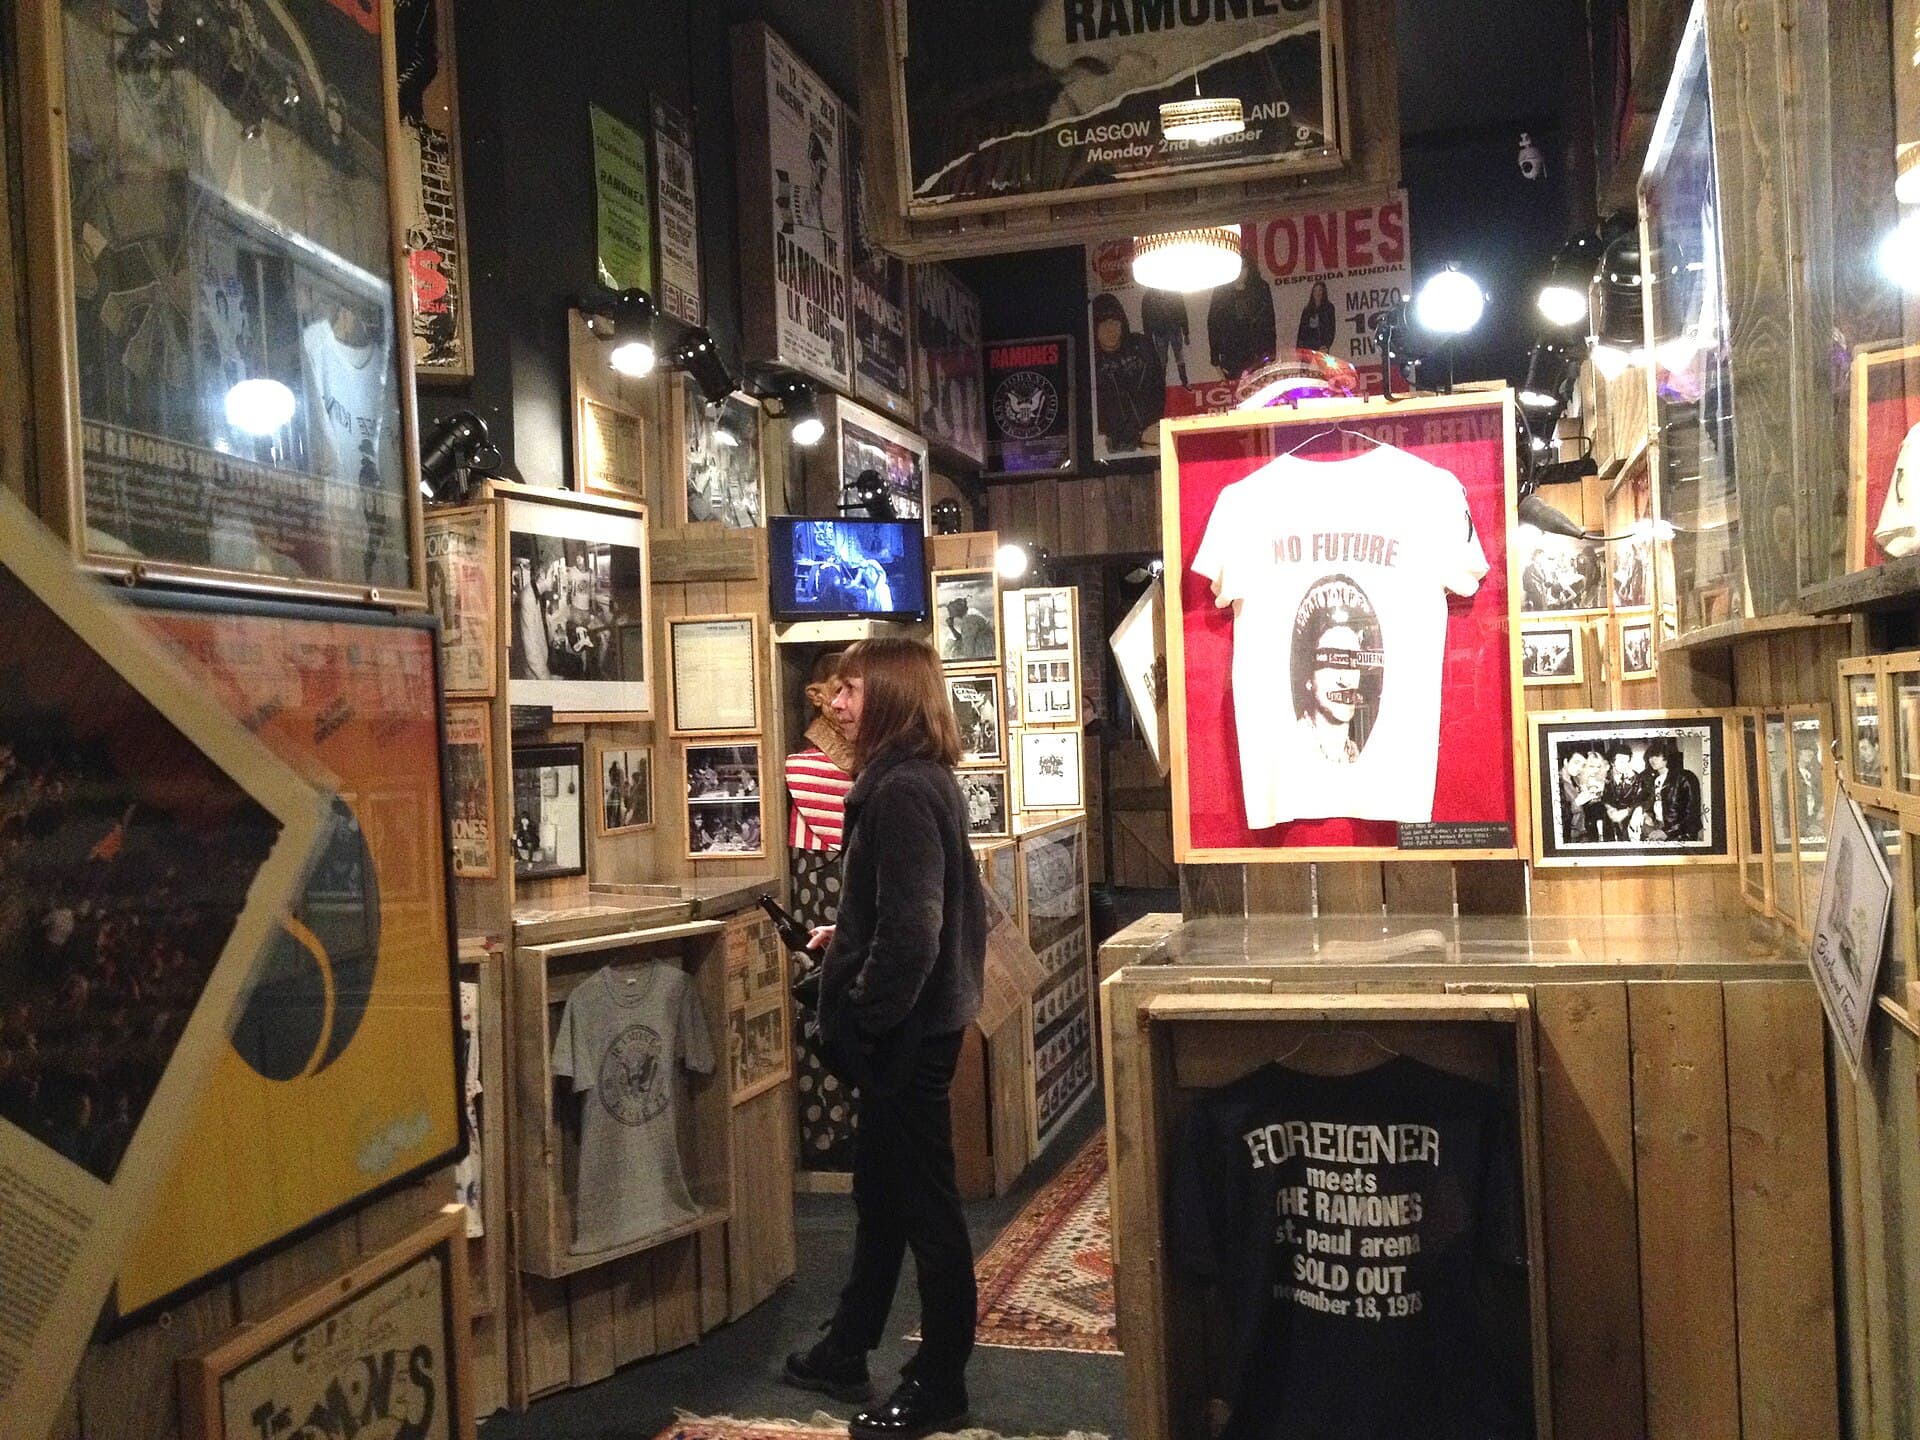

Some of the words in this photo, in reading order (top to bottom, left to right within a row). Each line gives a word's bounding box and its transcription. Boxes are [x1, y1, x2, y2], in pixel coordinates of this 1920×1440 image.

[1064, 0, 1312, 44] RAMO
[1057, 120, 1151, 148] GLASGOW
[1086, 142, 1154, 163] Monday
[1158, 138, 1189, 153] 2nd
[600, 169, 645, 206] RAMONES
[822, 231, 839, 271] THE
[776, 230, 845, 323] RAMONES
[1274, 271, 1344, 286] DESPEDIDA
[1348, 263, 1407, 278] MUNDIAL
[1345, 287, 1401, 312] MARZO
[806, 301, 831, 342] SUBS
[990, 343, 1059, 369] RAMONES
[1272, 535, 1301, 564] NO
[1311, 532, 1400, 568] FUTURE
[452, 818, 488, 840] ONES
[1242, 1120, 1440, 1169] FOREIGNER
[1306, 1167, 1377, 1193] meets
[1276, 1186, 1309, 1217] THE
[1315, 1191, 1424, 1228] RAMONES
[1306, 1228, 1351, 1256] paul
[1360, 1233, 1421, 1258] arena
[1293, 1253, 1350, 1293] SOLD
[1356, 1265, 1407, 1295] OUT
[1354, 1297, 1383, 1322] 18,
